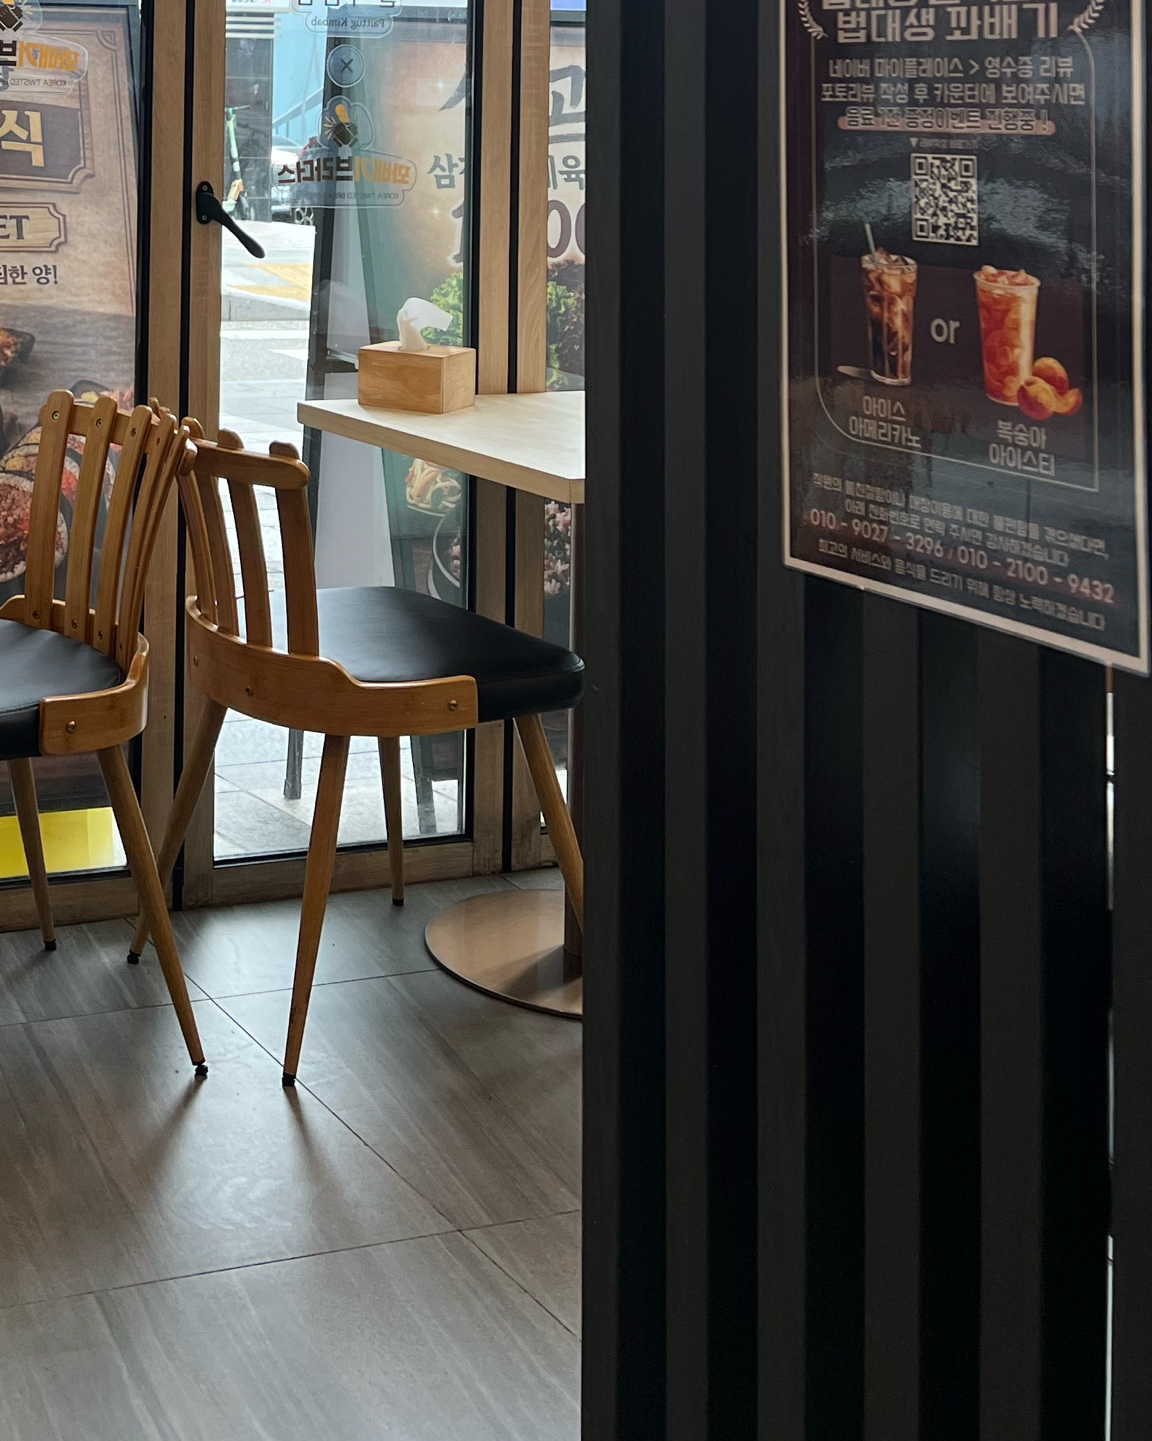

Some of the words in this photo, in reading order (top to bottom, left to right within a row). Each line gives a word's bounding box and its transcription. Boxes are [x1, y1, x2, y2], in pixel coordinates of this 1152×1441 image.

[837, 7, 936, 44] 법대생
[945, 3, 1059, 41] 꽈배기
[829, 58, 871, 78] 네이버
[874, 56, 965, 79] 마이플레이스
[984, 56, 1034, 78] 영수증
[1038, 55, 1074, 78] 리뷰
[821, 82, 876, 103] 포토리뷰
[879, 82, 909, 104] 작성
[913, 82, 930, 104] 후
[933, 82, 996, 104] 카운터에
[1001, 82, 1086, 105] 보여주시면
[847, 105, 875, 129] 음료
[904, 106, 982, 131] 증정이벤트
[985, 107, 1035, 132] 진행중
[32, 264, 59, 285] 양!
[930, 316, 961, 345] or
[862, 395, 907, 422] 아이스
[848, 416, 922, 448] 아메리카노
[997, 420, 1047, 449] 복숭아
[989, 443, 1056, 477] 아이스티
[844, 498, 865, 517] 아래
[923, 517, 946, 537] 연락
[966, 507, 989, 528] 대한
[810, 508, 836, 530] 010
[852, 518, 889, 544] 9027
[905, 531, 944, 557] 3296
[957, 545, 988, 570] 010
[1006, 558, 1049, 585] 2100
[1067, 573, 1115, 604] 9432
